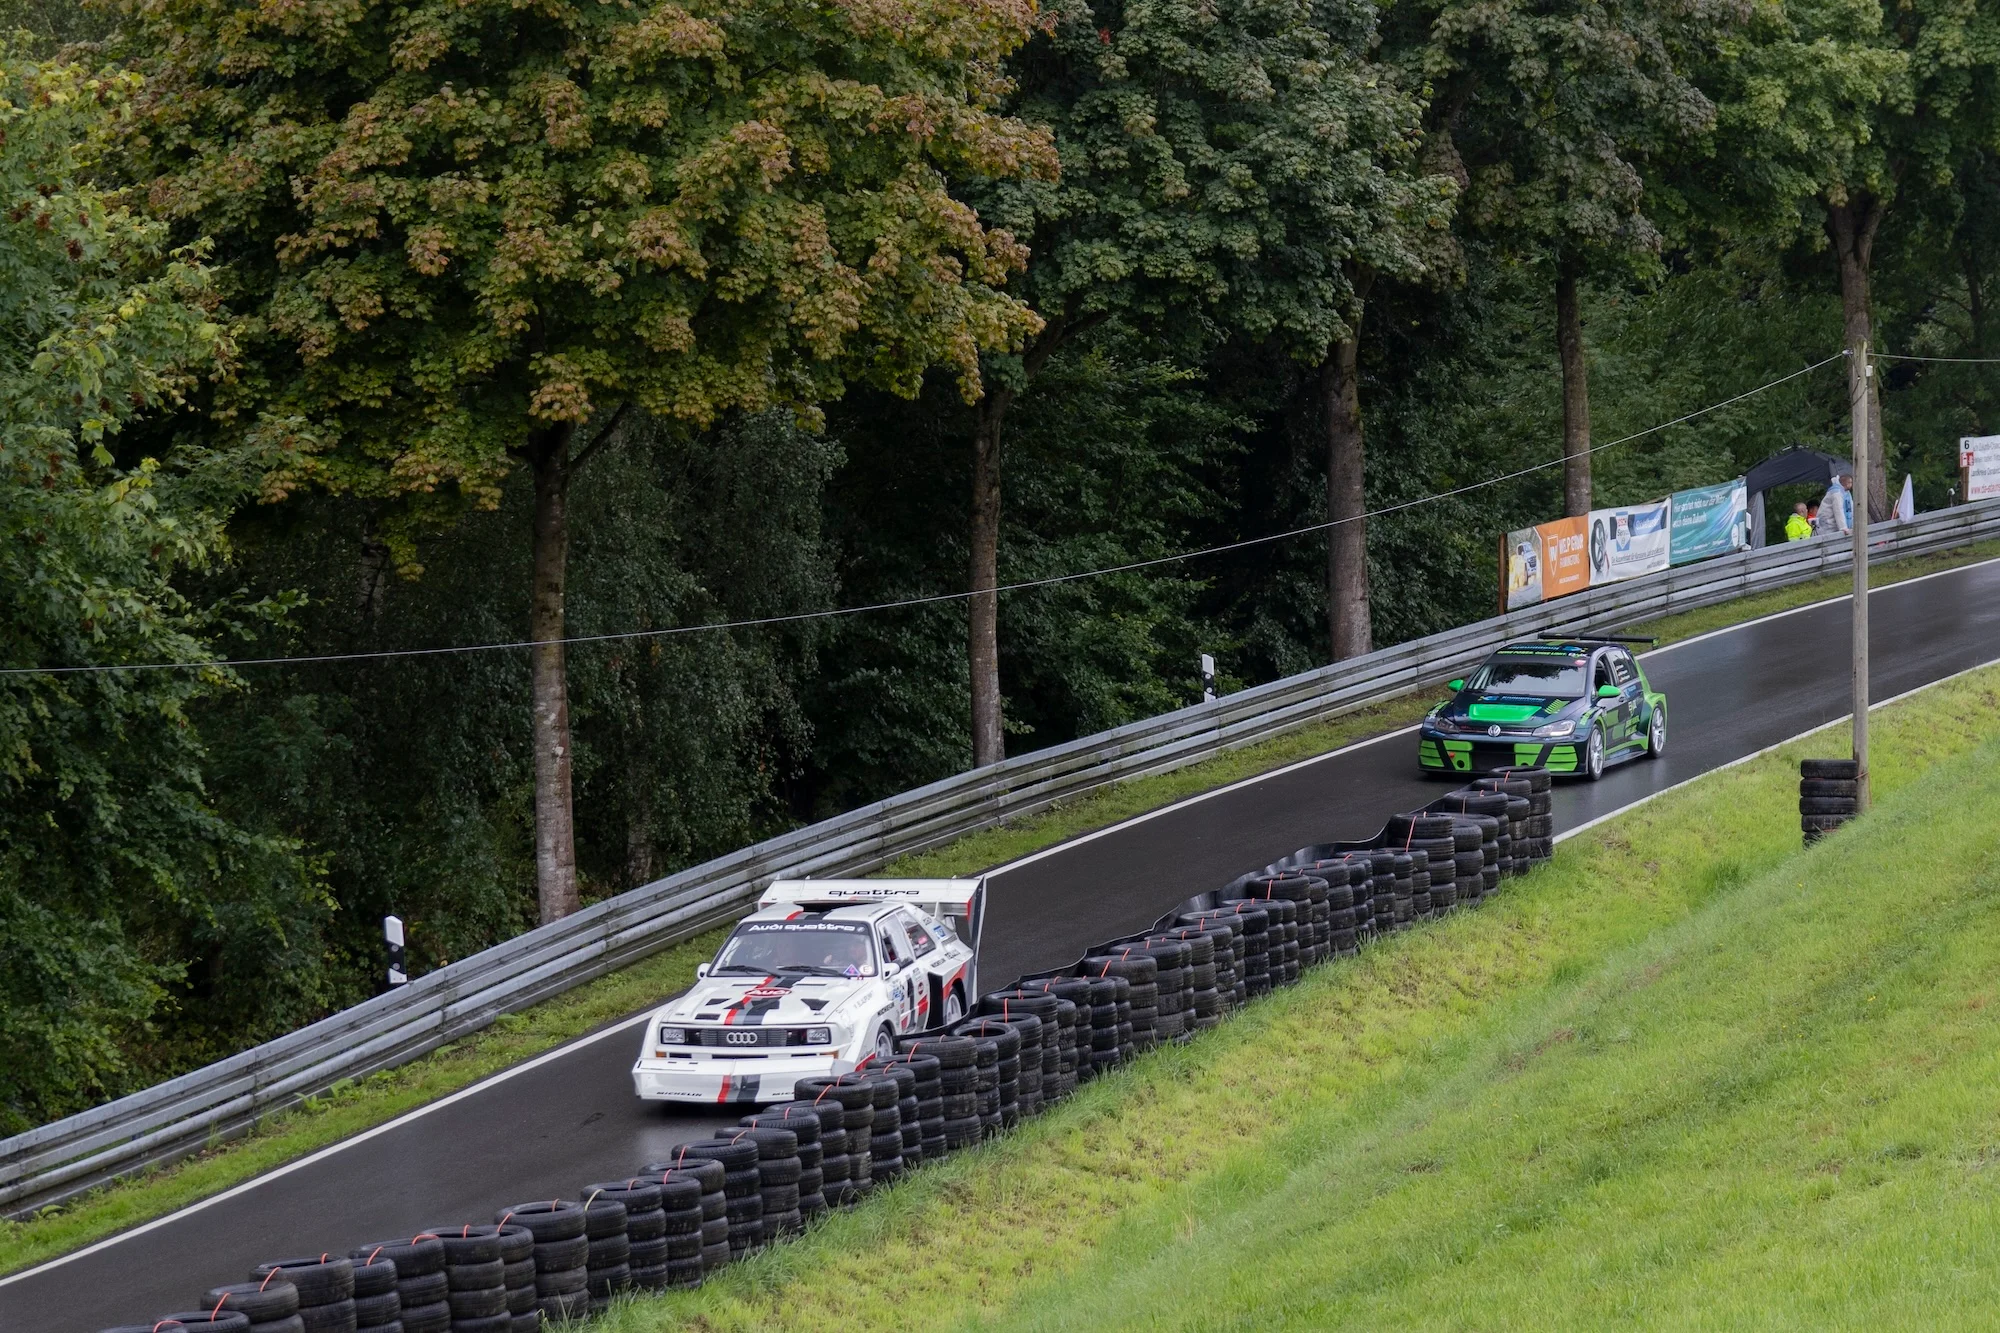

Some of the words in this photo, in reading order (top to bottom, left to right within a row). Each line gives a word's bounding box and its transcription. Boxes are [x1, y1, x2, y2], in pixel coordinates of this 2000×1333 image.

[1964, 440, 1970, 450] 6
[828, 889, 920, 897] quattro
[748, 923, 783, 932] Audi
[784, 924, 856, 933] quattro
